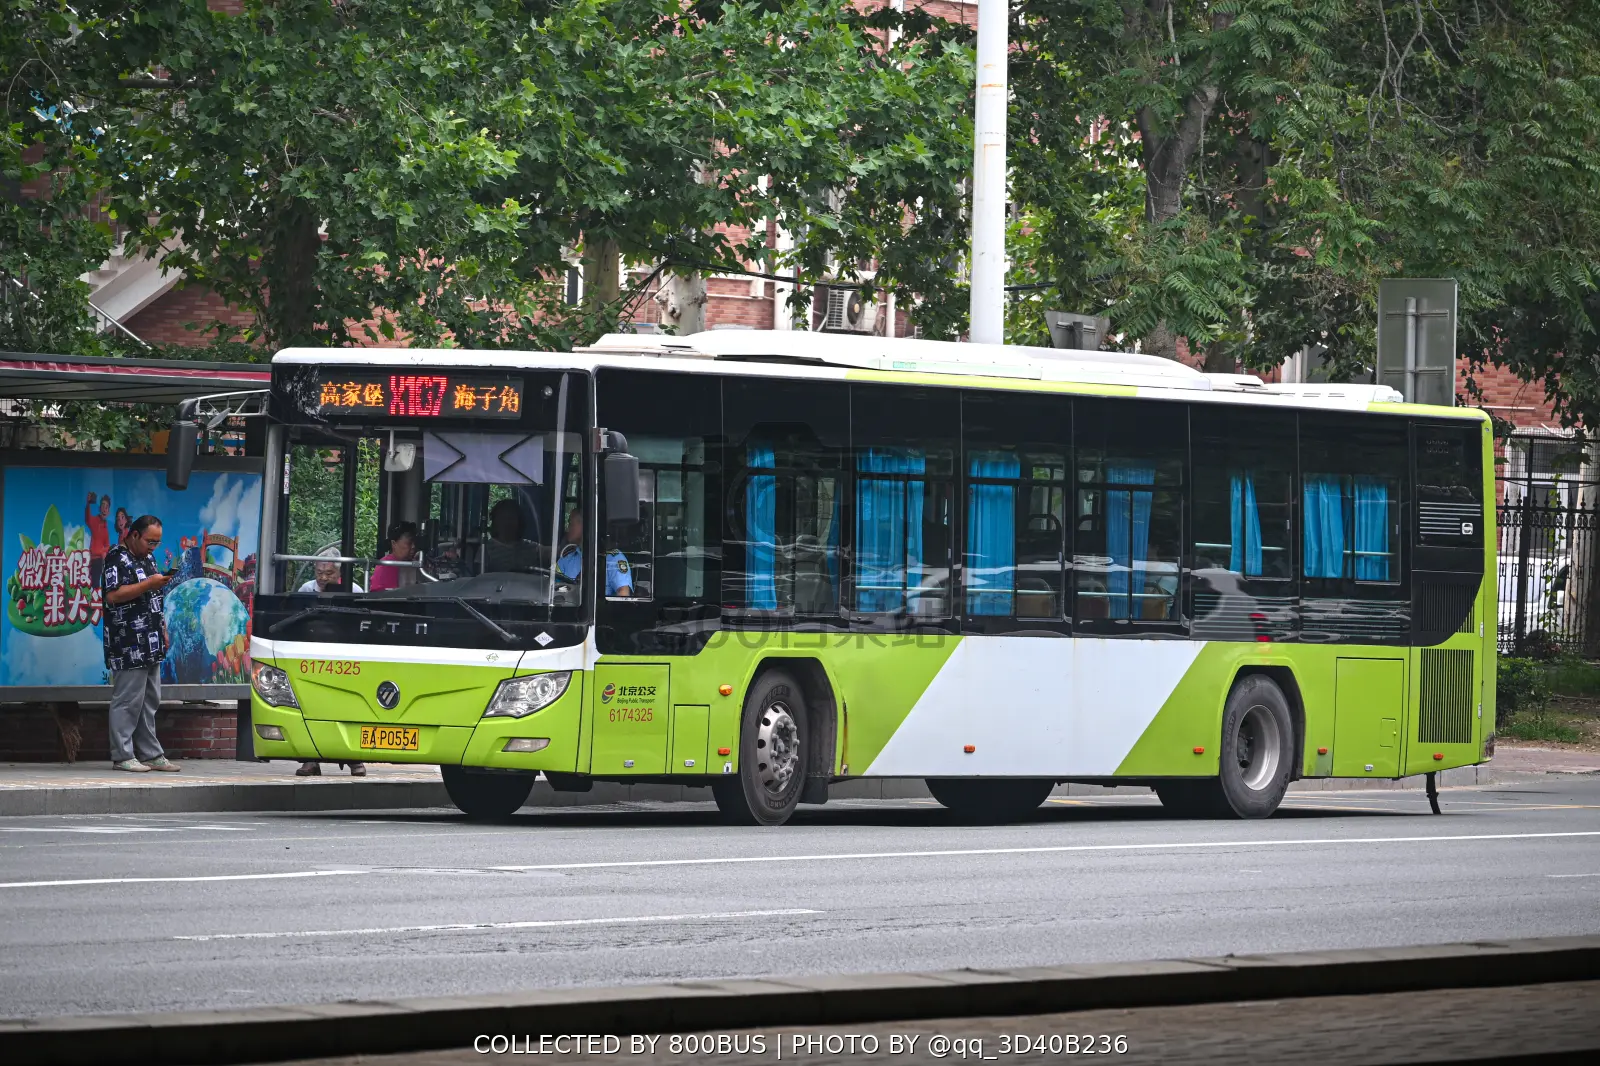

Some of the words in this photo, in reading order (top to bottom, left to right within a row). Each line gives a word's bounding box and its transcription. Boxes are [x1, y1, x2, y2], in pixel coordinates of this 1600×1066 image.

[319, 380, 385, 408] 高家堡
[389, 375, 448, 416] X107
[454, 383, 520, 413] 海子角
[19, 546, 92, 590] 微度假
[300, 659, 361, 676] 6174325
[618, 686, 657, 696] 北京公交
[609, 708, 653, 722] 6174325
